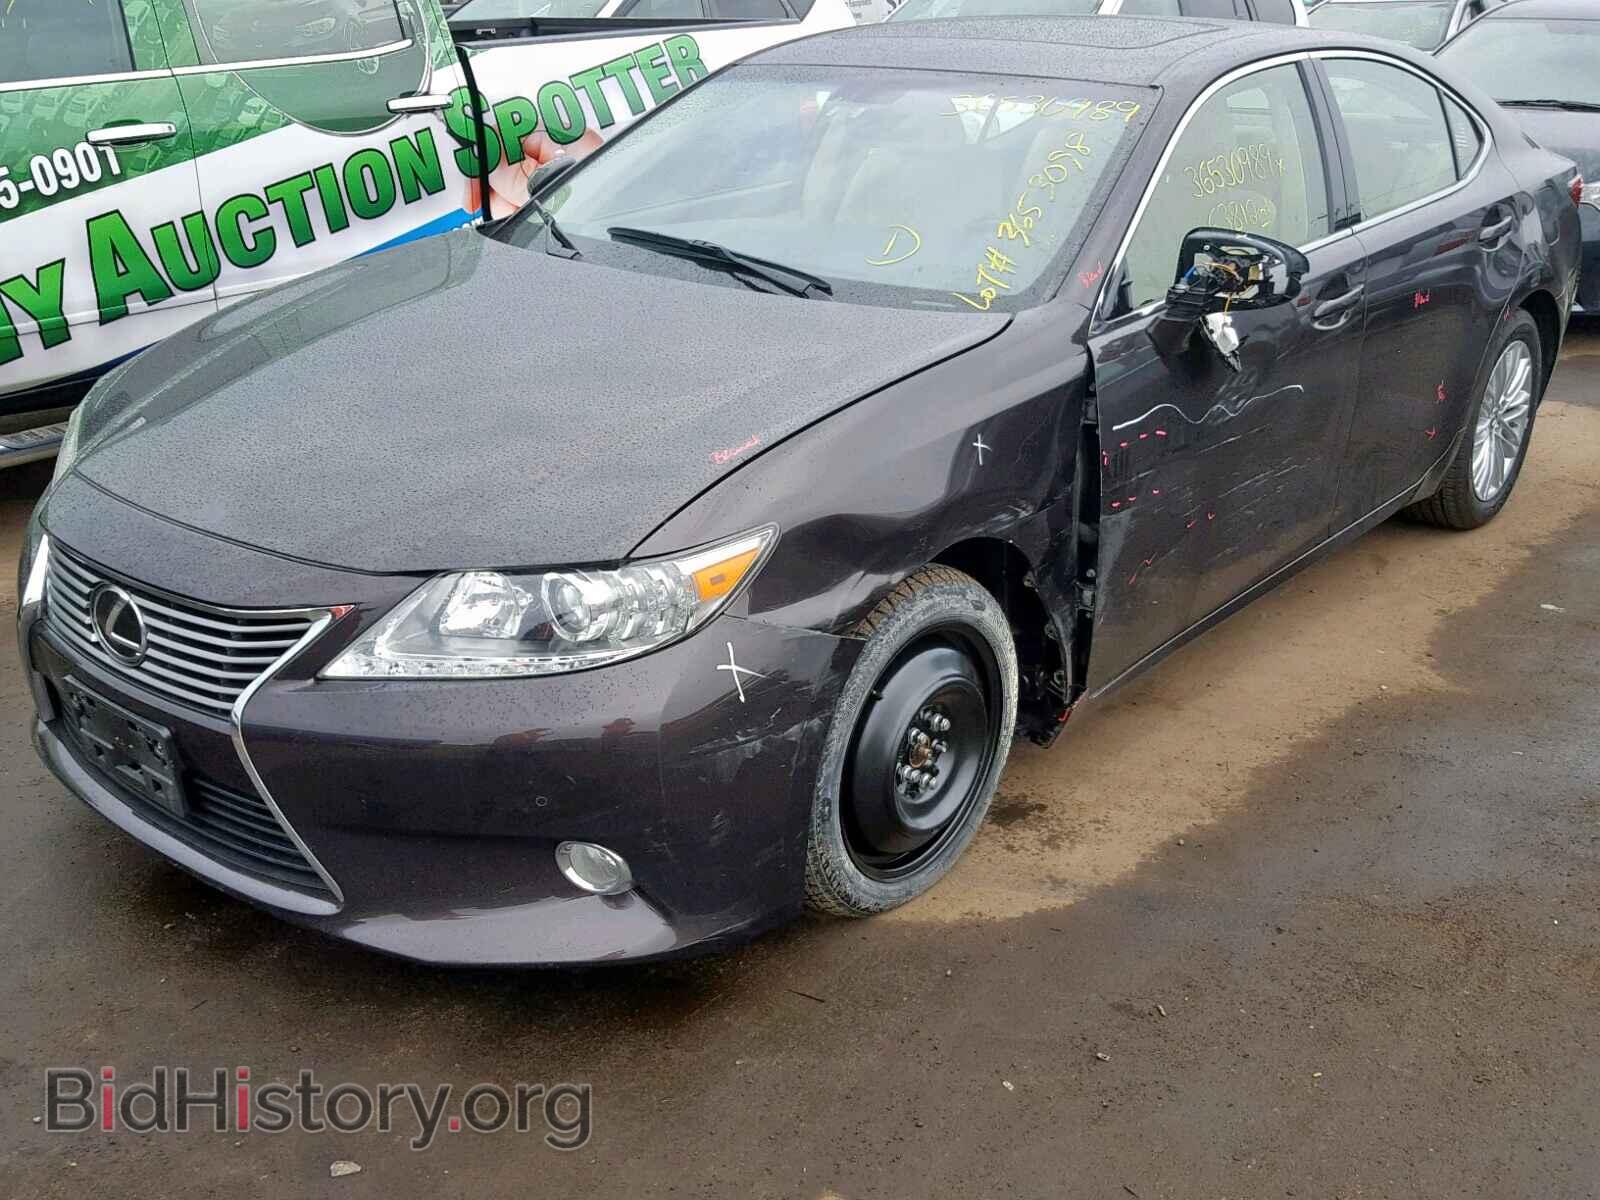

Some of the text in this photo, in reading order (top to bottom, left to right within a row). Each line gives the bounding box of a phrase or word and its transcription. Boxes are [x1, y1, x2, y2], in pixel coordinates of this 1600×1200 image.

[0, 141, 121, 209] 5-0901
[86, 127, 446, 326] AUCTION
[443, 33, 710, 178] SPOTTER
